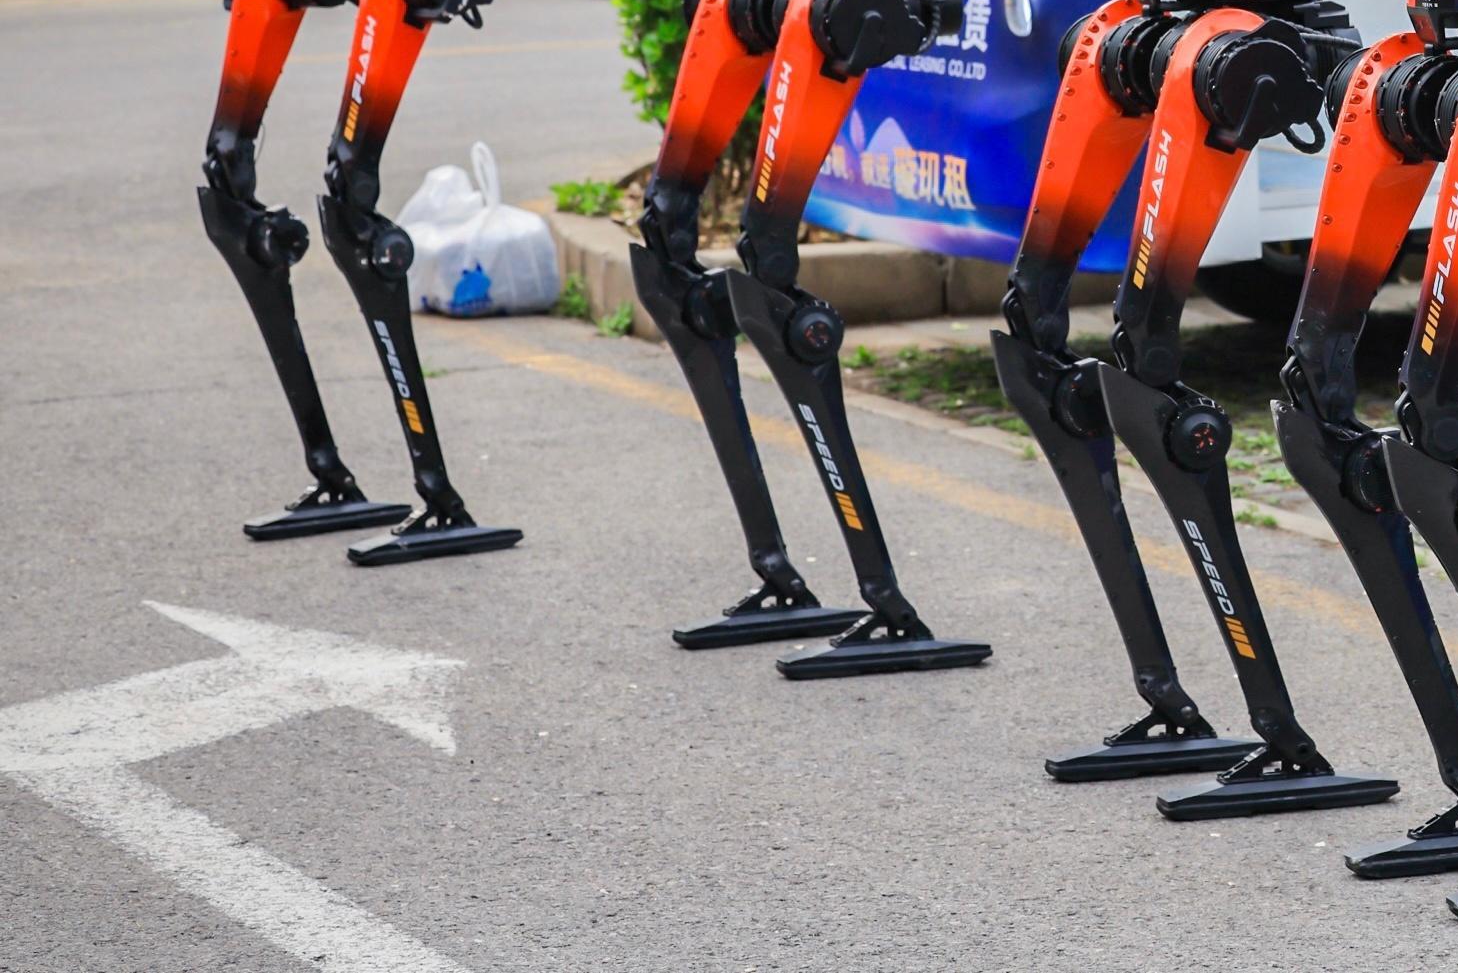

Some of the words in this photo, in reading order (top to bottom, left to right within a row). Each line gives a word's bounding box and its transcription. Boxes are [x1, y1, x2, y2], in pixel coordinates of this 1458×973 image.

[351, 15, 377, 104] FLASH
[765, 61, 793, 161] FLASH
[1142, 128, 1174, 242] FLASH
[374, 319, 411, 399] SPEED
[798, 403, 845, 492] SPEED
[1182, 518, 1235, 616] SPEED
